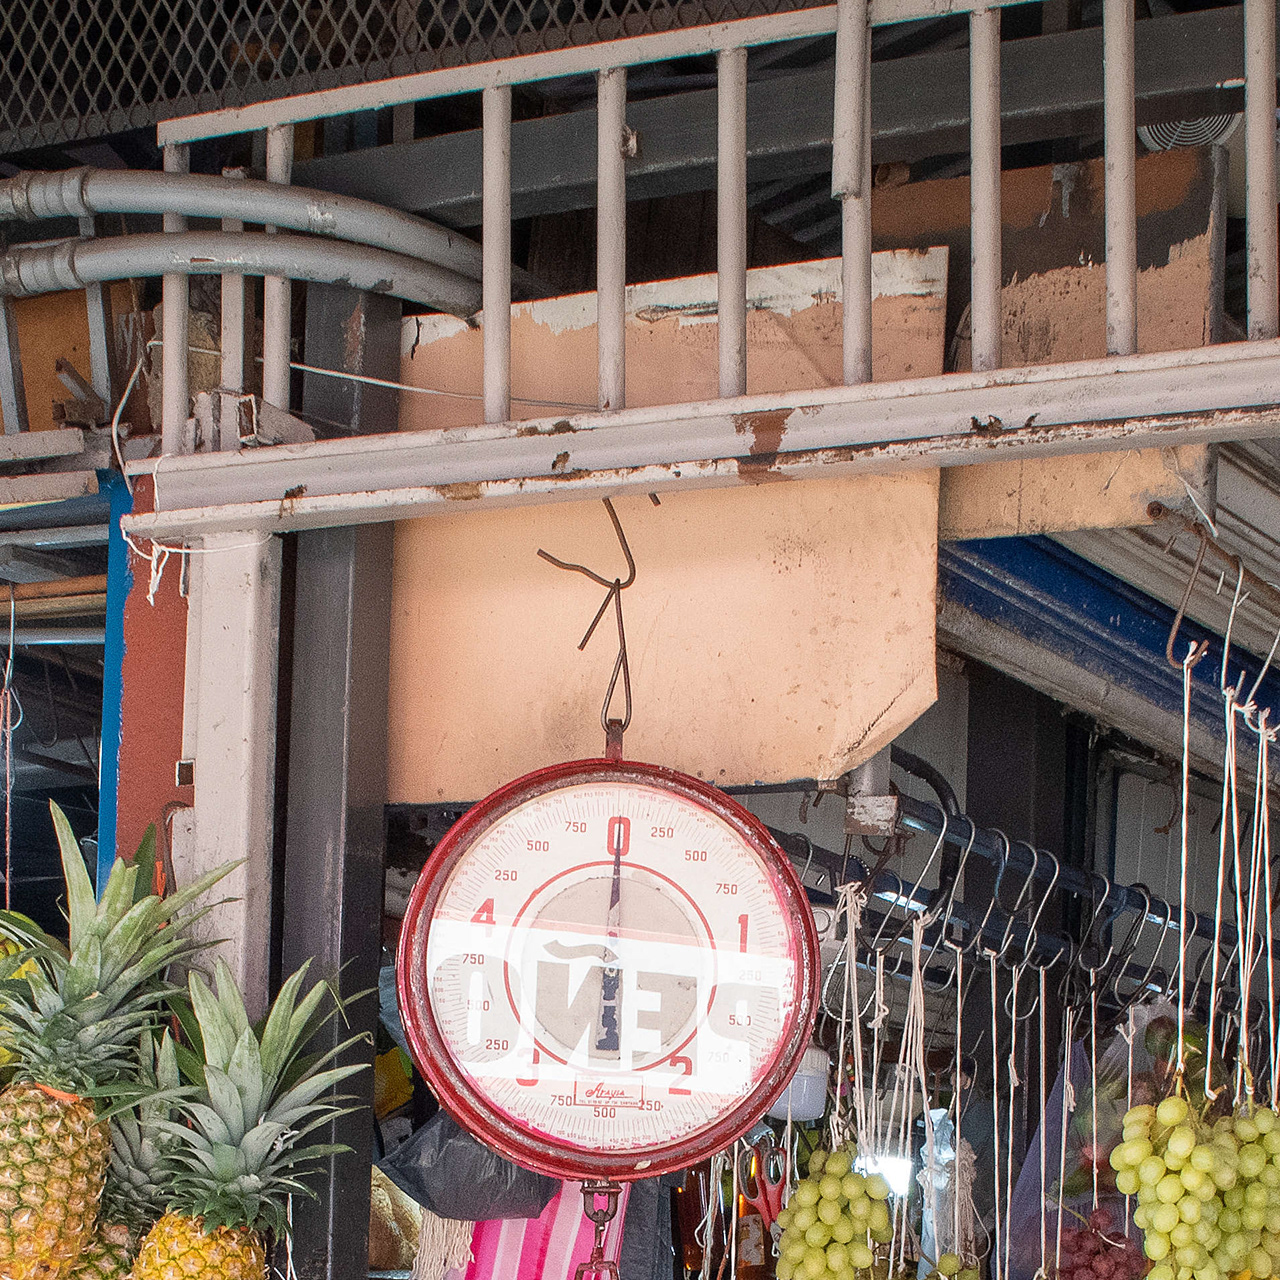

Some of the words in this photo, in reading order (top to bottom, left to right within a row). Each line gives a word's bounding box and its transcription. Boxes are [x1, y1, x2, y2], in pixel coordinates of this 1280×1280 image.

[565, 821, 587, 833] 750
[651, 827, 674, 838] 250
[607, 816, 630, 856] 0
[526, 840, 550, 852] 500
[684, 850, 708, 862] 500
[494, 870, 518, 882] 250
[716, 884, 738, 895] 750
[471, 898, 496, 937] 4
[738, 914, 748, 953] 1
[462, 953, 484, 965] 750
[486, 1039, 508, 1050] 250
[668, 1055, 693, 1096] 2
[550, 1094, 573, 1107] 750
[638, 1100, 661, 1112] 250
[593, 1107, 616, 1119] 500
